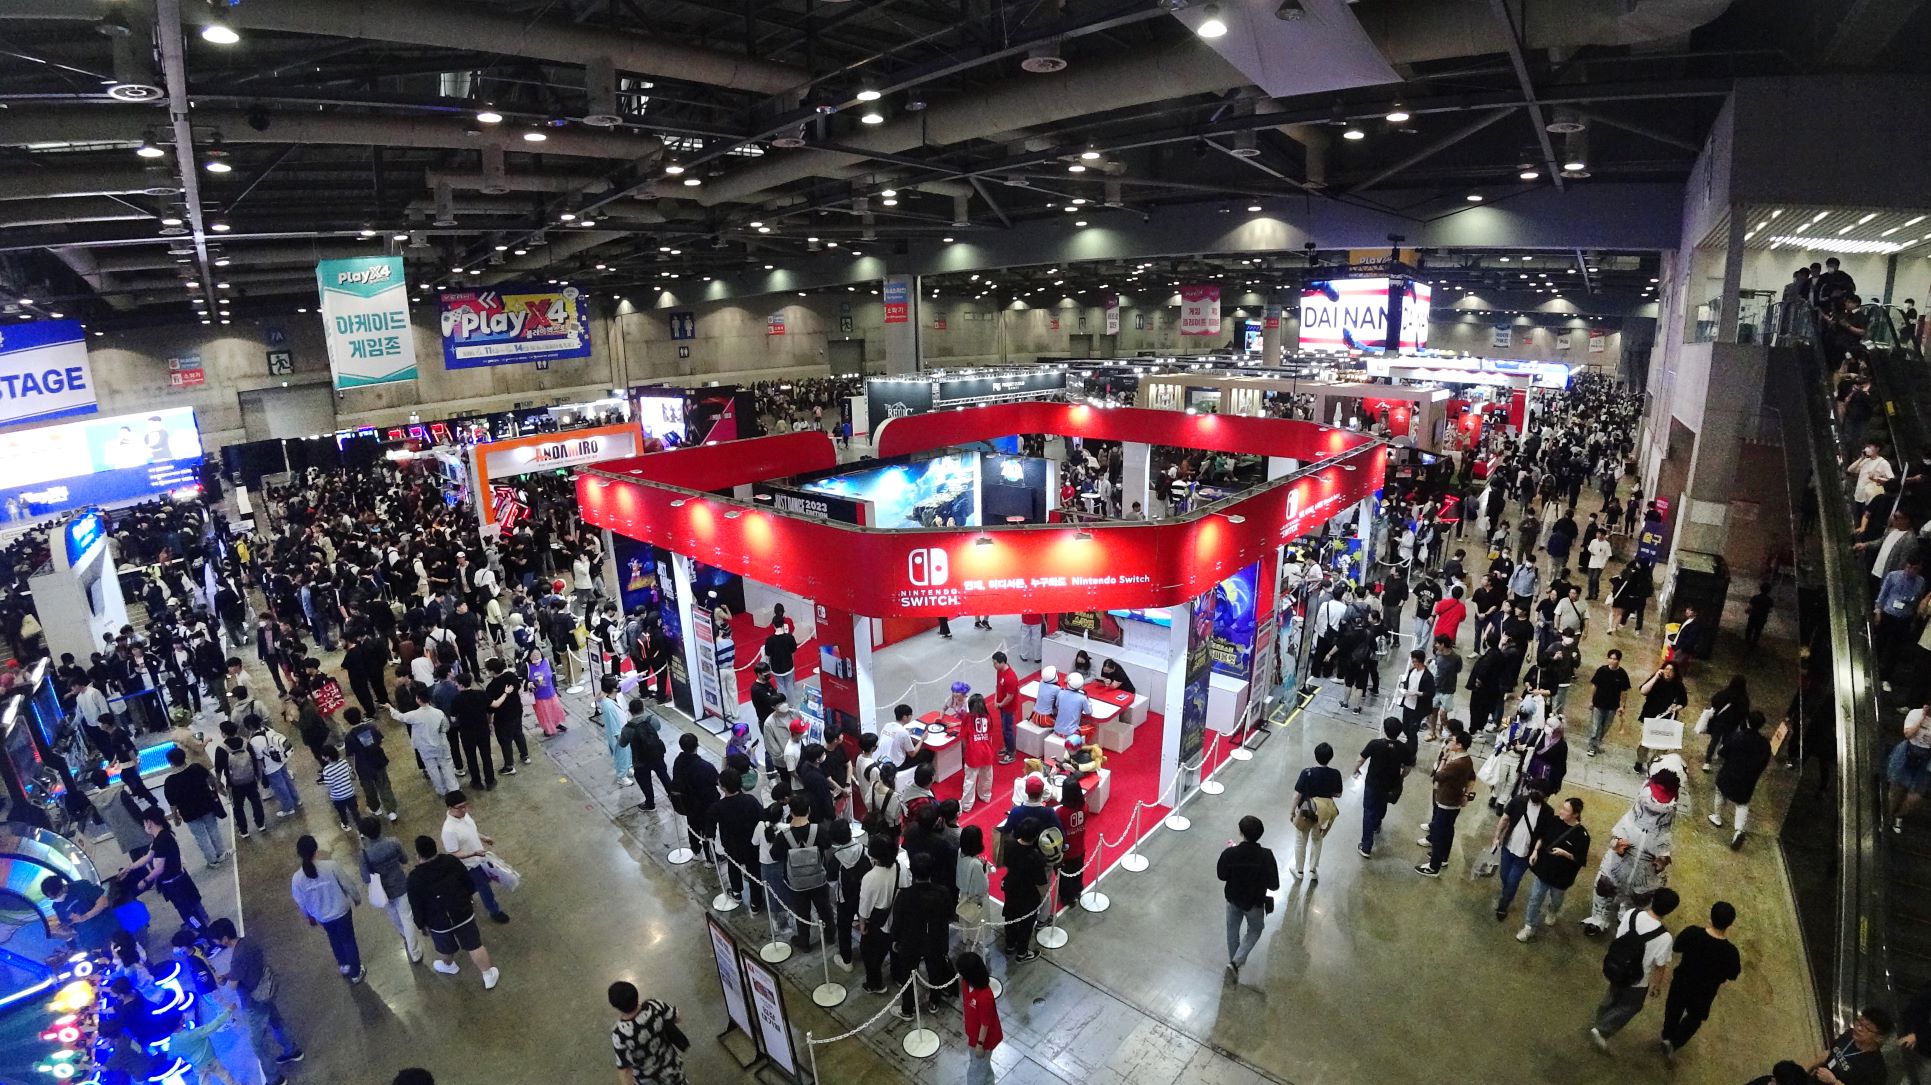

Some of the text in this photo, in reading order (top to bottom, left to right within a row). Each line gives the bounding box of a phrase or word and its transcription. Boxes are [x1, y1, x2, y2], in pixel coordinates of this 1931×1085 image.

[338, 264, 391, 284] PlayX4
[335, 311, 407, 334] 아케이드
[461, 299, 568, 338] PlayX4
[349, 336, 401, 358] 게임존
[0, 366, 87, 399] TAGE
[535, 440, 599, 463] ANDAMIRO
[773, 492, 787, 510] JUST
[805, 499, 828, 513] 2023
[1071, 576, 1116, 587] Nintendo
[1119, 574, 1150, 585] Switch
[900, 589, 957, 597] NINTENDO
[901, 595, 959, 607] SWITCH
